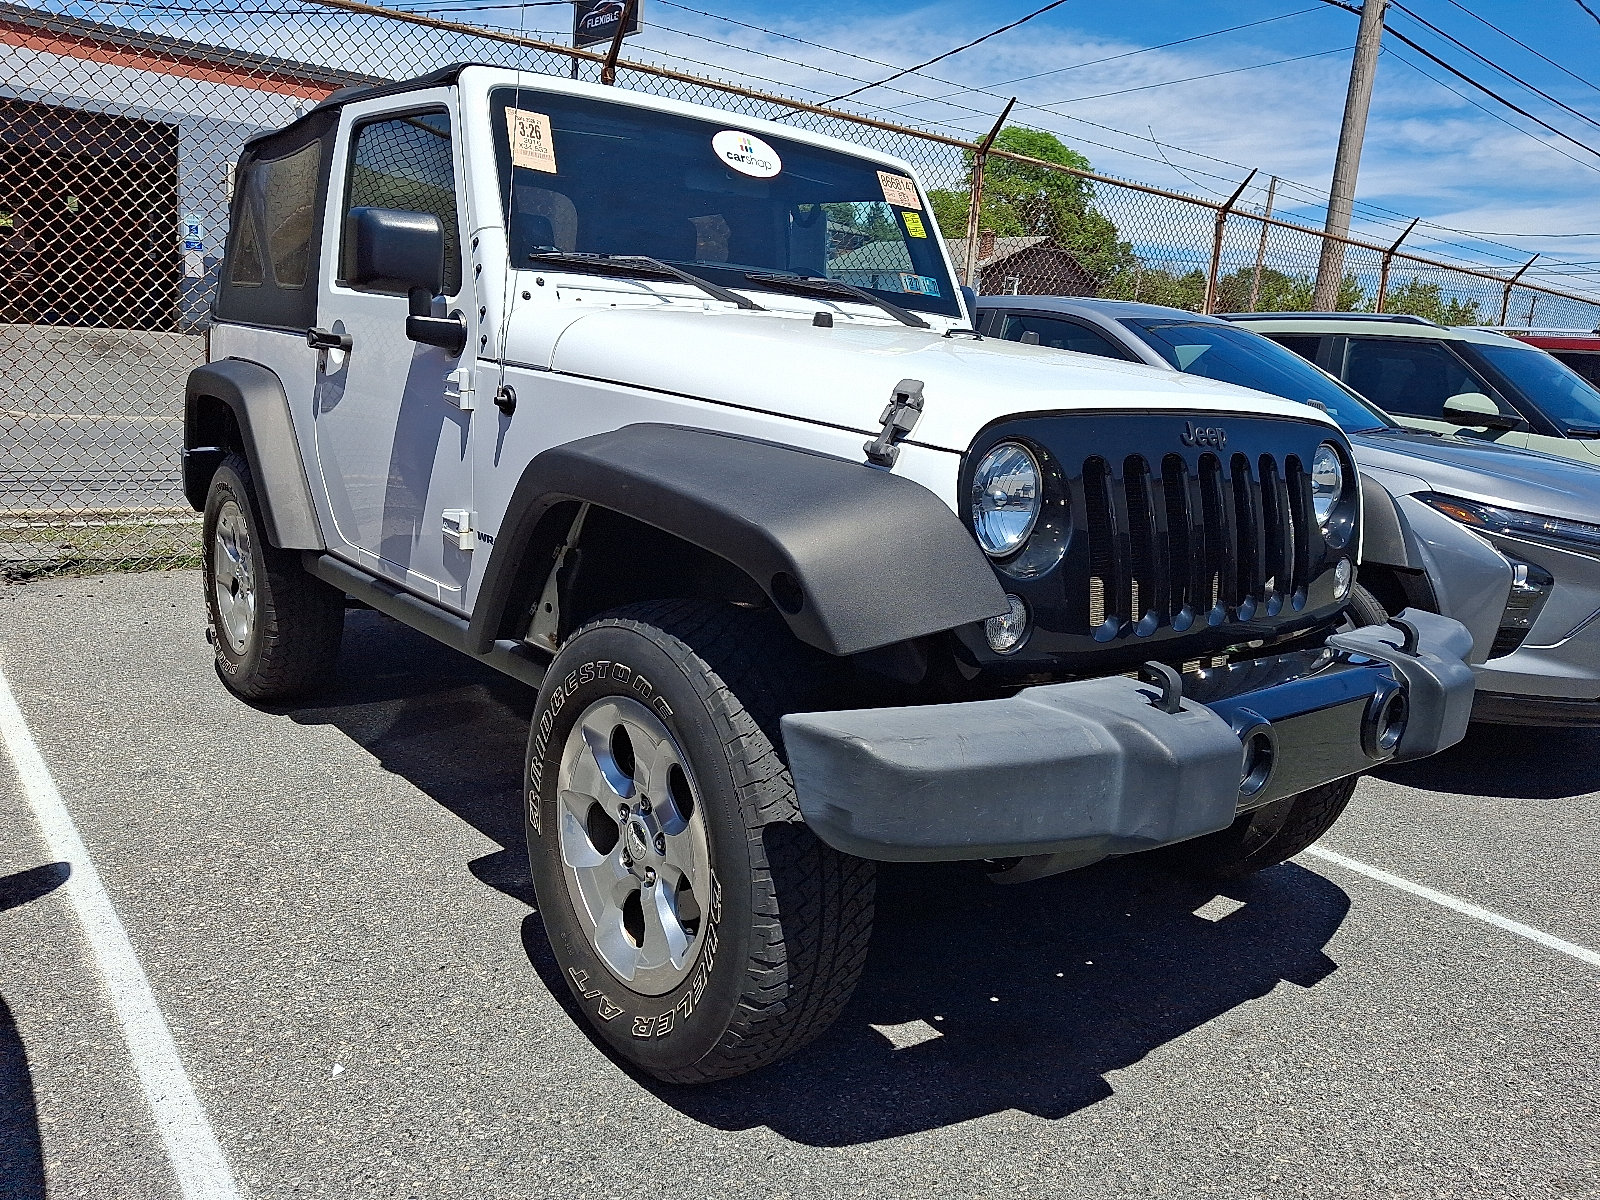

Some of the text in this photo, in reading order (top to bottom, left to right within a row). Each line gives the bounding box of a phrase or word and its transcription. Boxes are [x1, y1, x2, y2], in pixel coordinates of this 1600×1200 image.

[587, 11, 619, 28] FLEXIBLE
[519, 121, 541, 140] 3:26
[726, 151, 772, 171] carshop
[1180, 420, 1227, 451] Jeep
[528, 660, 674, 836] BRIDGESTONE
[569, 868, 722, 1037] DUELER A/T
